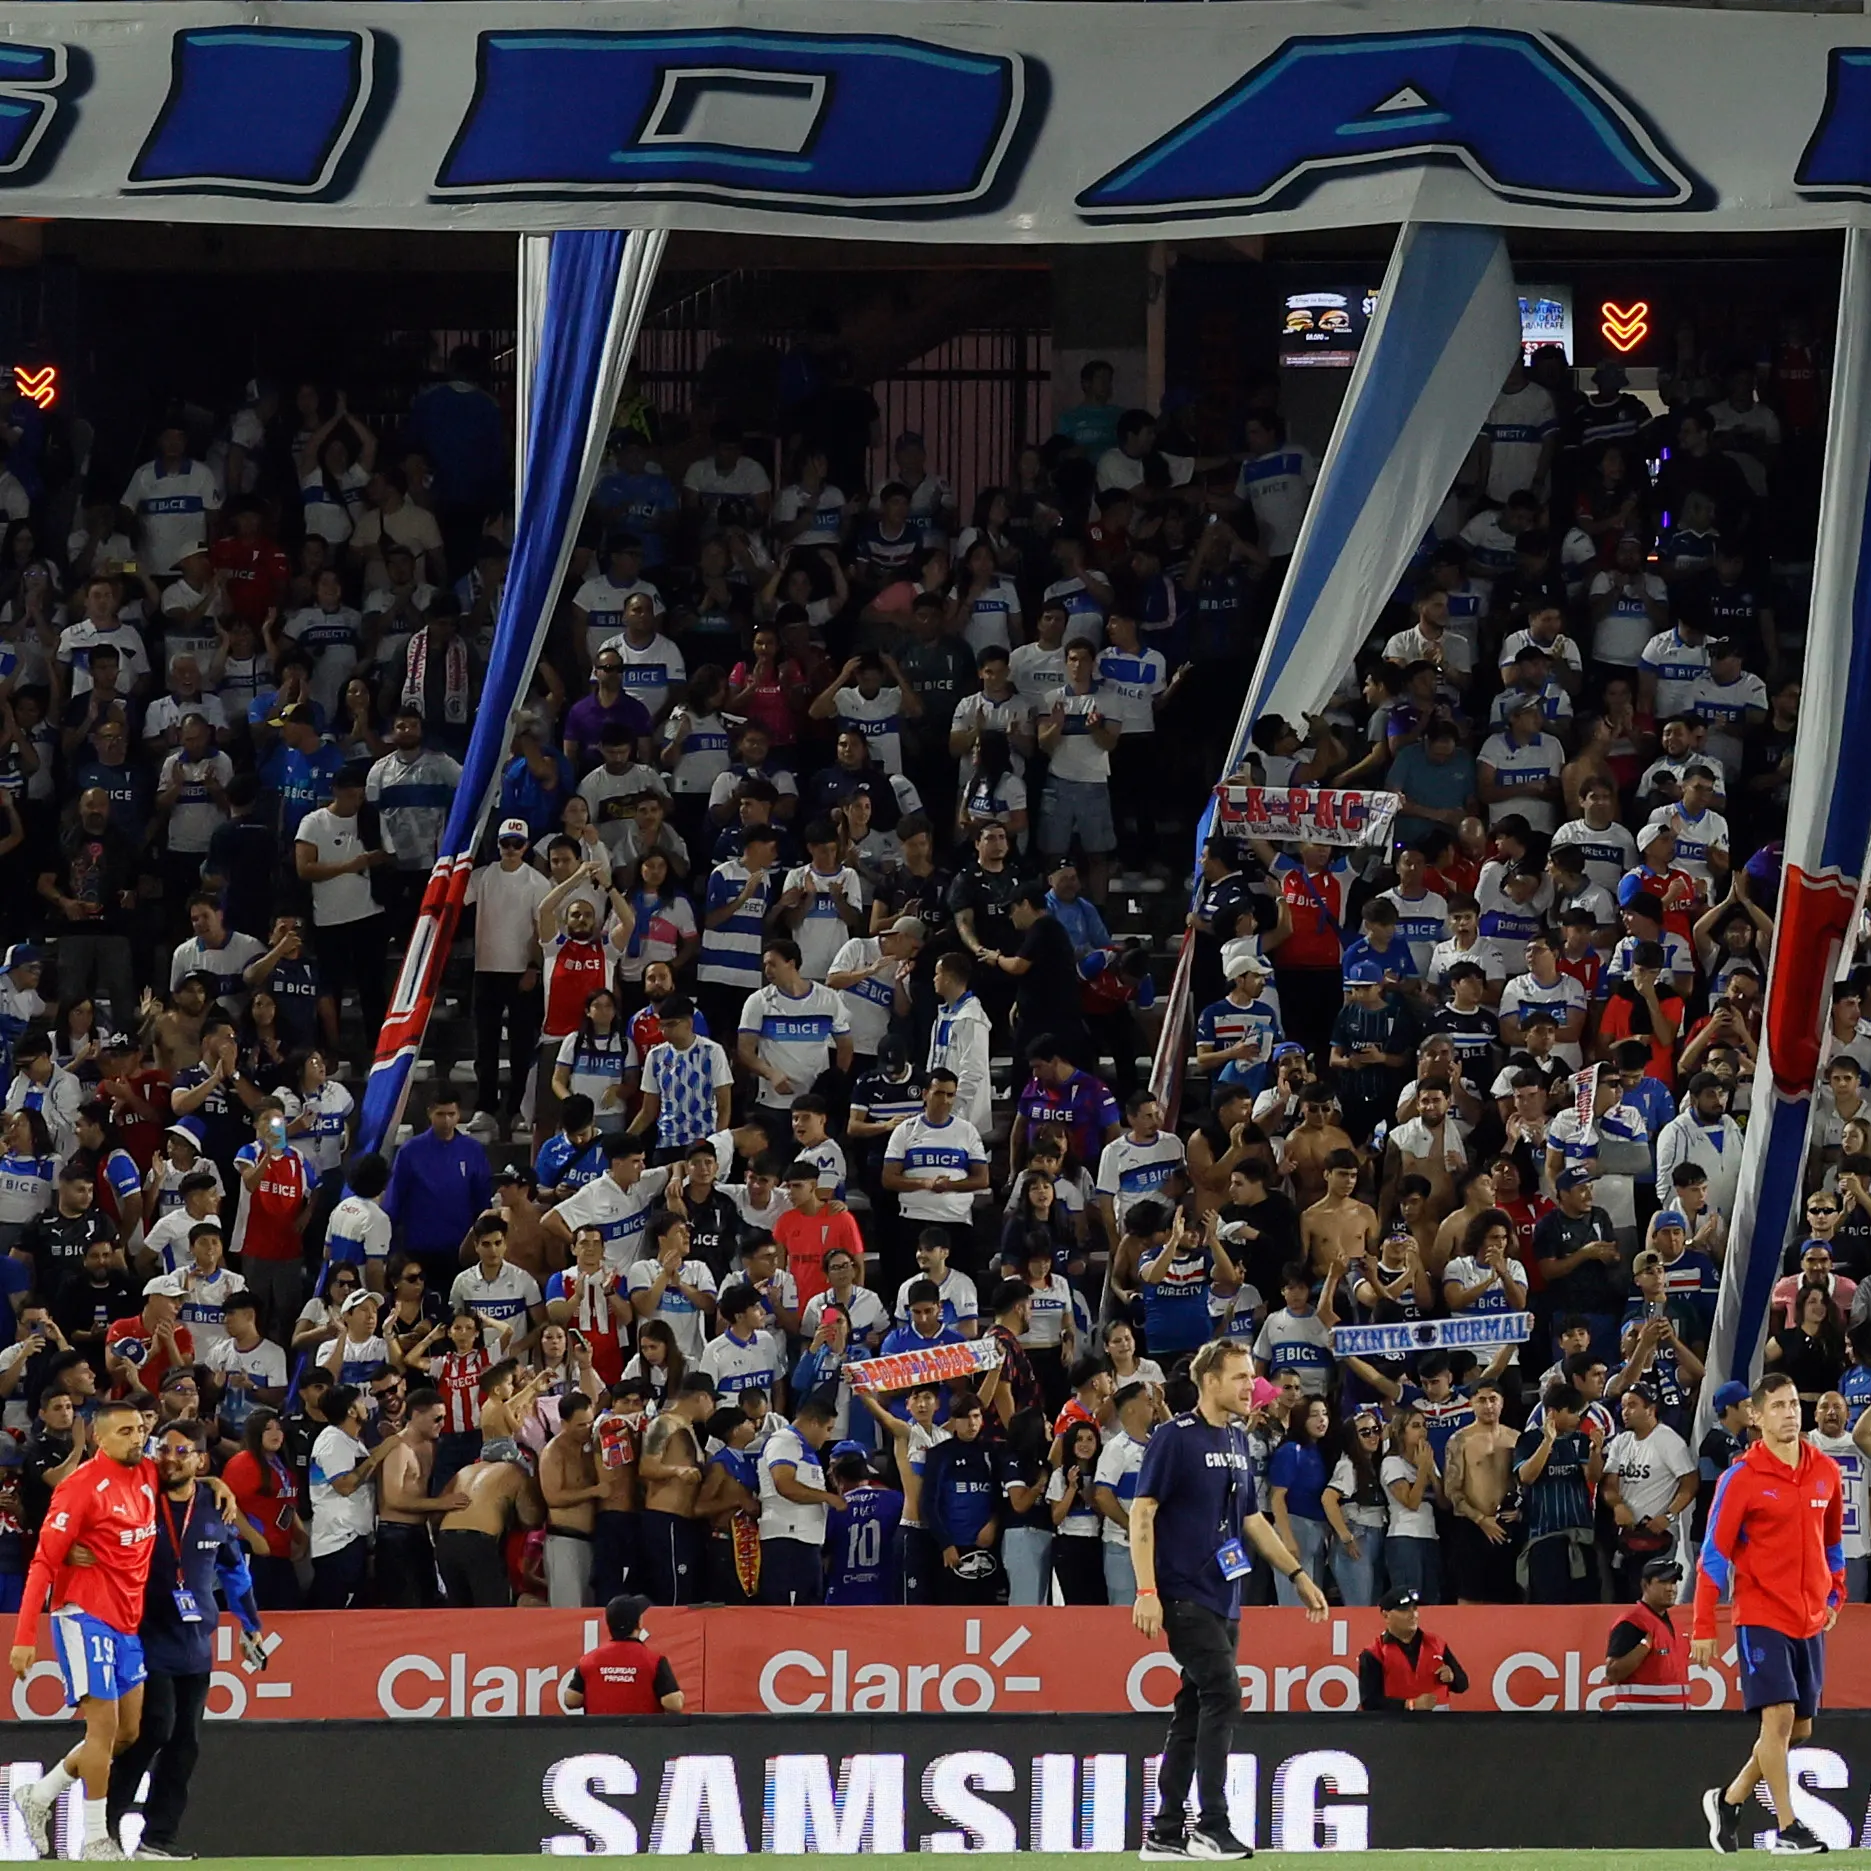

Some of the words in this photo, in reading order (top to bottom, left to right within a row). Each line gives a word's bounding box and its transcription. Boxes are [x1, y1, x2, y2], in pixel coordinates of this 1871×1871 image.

[627, 672, 658, 682] BICE
[1116, 687, 1144, 699] BICE
[1217, 787, 1271, 822] LA
[1287, 787, 1364, 832] PAC
[508, 820, 522, 830] UC
[1407, 924, 1435, 934] BICE
[286, 985, 316, 995] BICE
[789, 1023, 819, 1033] BICE
[1042, 1108, 1073, 1121] BICE
[6, 1180, 38, 1193] BICE
[271, 1183, 295, 1197] BICE
[1156, 1286, 1202, 1296] DIRECTV
[1477, 1296, 1507, 1308] BICE
[1441, 1314, 1529, 1345] NORMAL
[1287, 1346, 1317, 1360] BICE
[1619, 1465, 1649, 1478] BOSS
[847, 1522, 882, 1569] 10
[91, 1635, 116, 1664] 19
[600, 1667, 636, 1676] SEGURIDAD
[603, 1675, 634, 1683] PRIVADA
[759, 1648, 995, 1714] Claro
[1127, 1649, 1362, 1713] Caro
